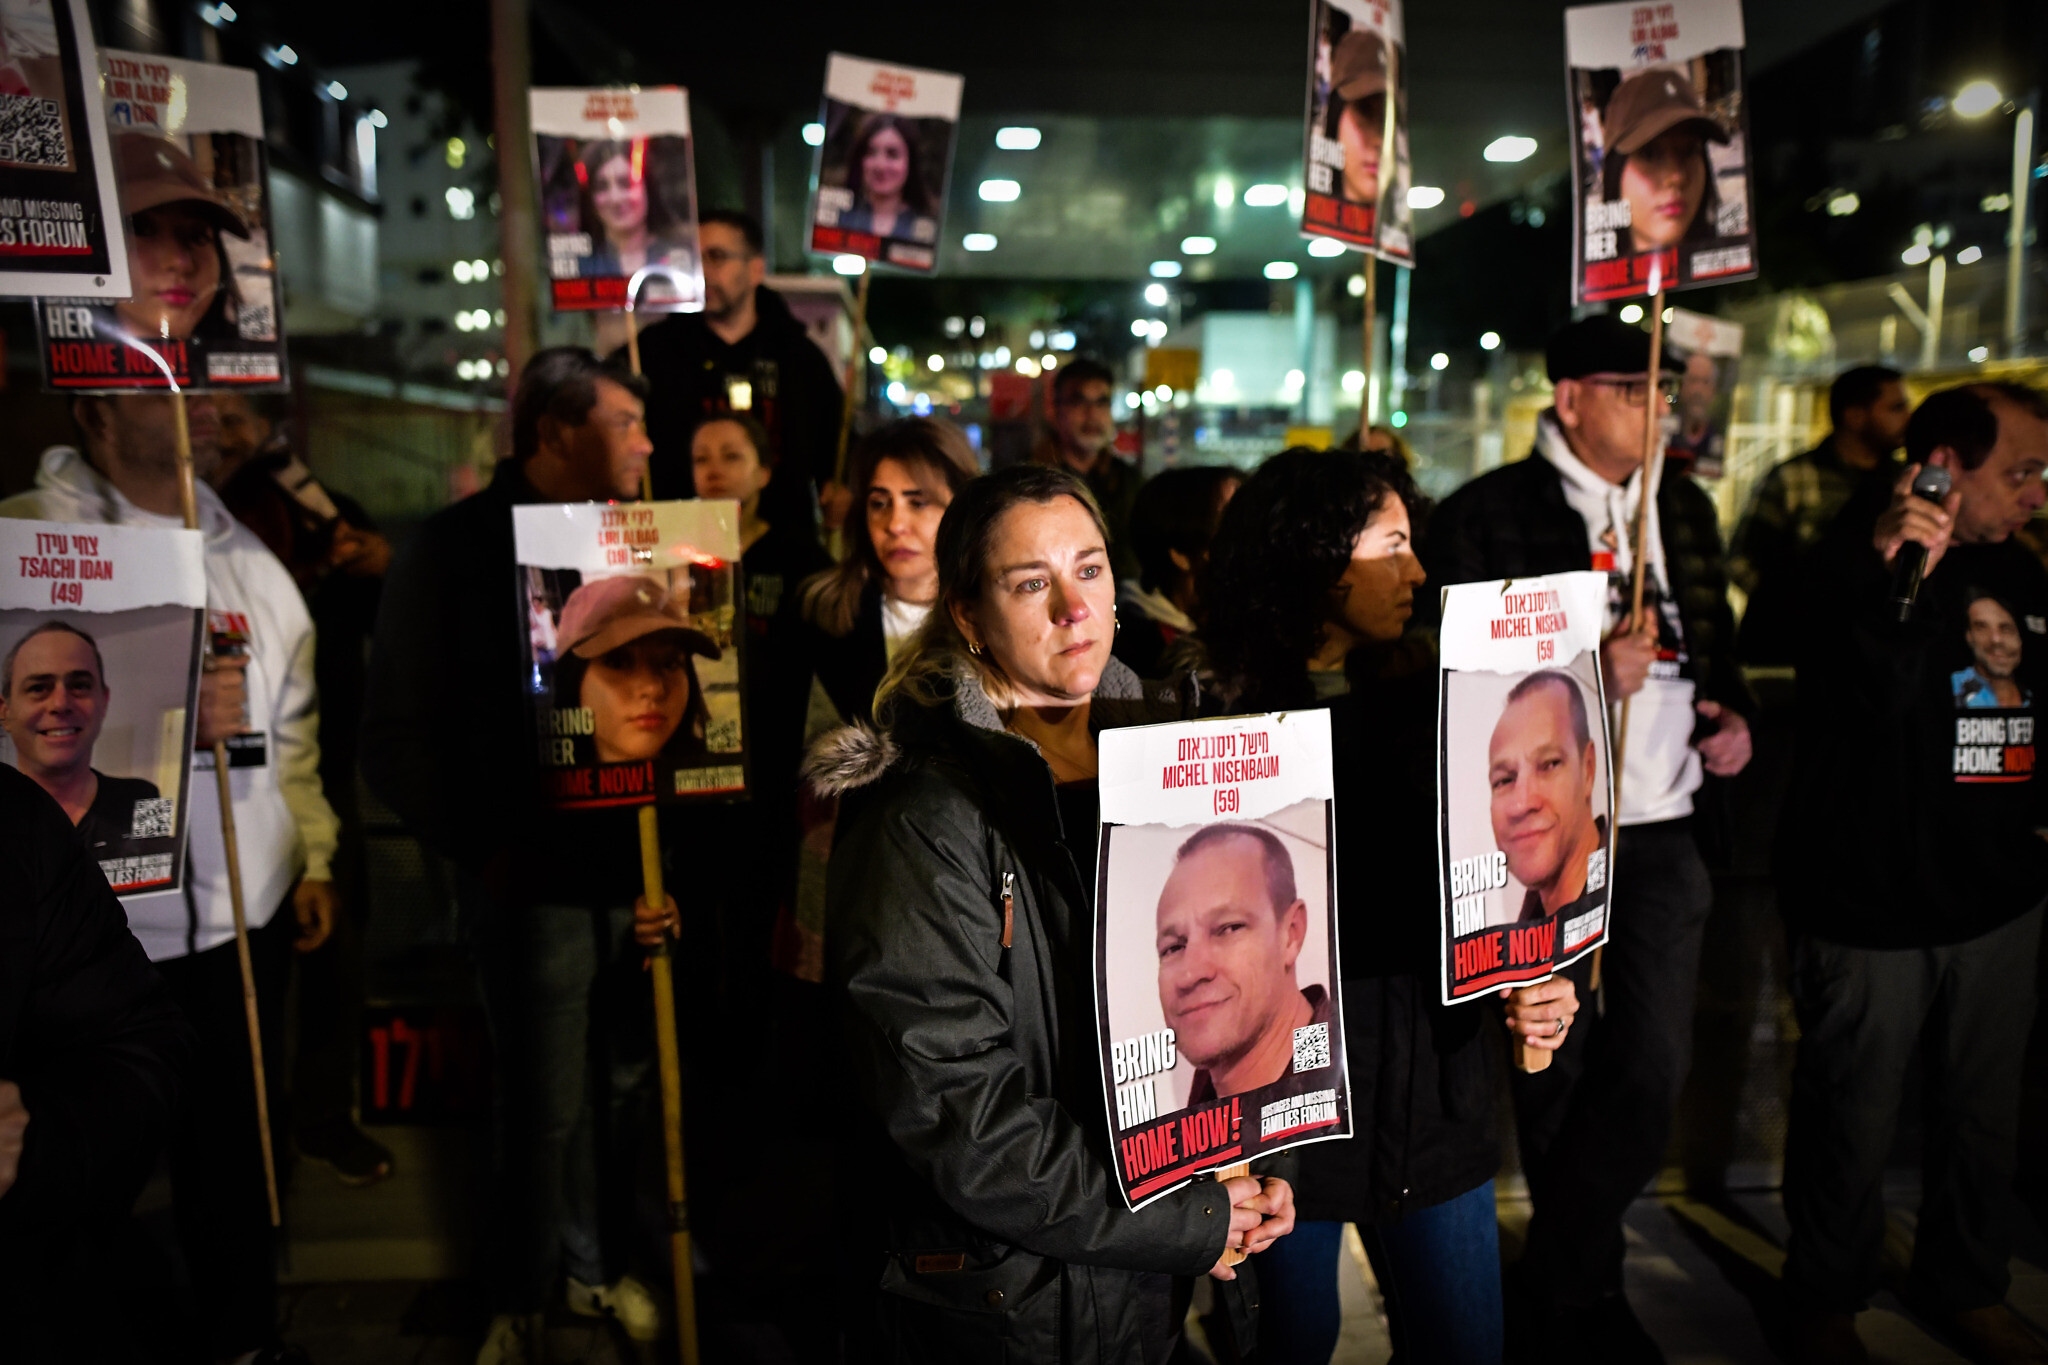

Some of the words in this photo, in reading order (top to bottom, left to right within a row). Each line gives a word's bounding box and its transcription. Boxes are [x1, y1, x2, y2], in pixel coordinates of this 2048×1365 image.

[24, 199, 84, 221] MISSING
[17, 219, 88, 248] FORUM
[1585, 231, 1618, 261] HER
[47, 305, 95, 338] HER
[50, 342, 118, 374] HOME
[36, 532, 68, 556] עידן
[72, 535, 99, 556] צחי
[19, 556, 76, 580] TSACHI
[79, 559, 114, 581] IDAN
[51, 581, 83, 606] (49)
[1490, 616, 1533, 640] MICHEL
[1239, 731, 1269, 756] מישל
[1956, 717, 2006, 746] BRING
[1177, 736, 1236, 762] ניסנבאום
[1952, 745, 2003, 774] HOME
[598, 760, 655, 793] NOW!
[1162, 765, 1209, 790] MICHEL
[1212, 755, 1280, 784] NISENBAUM
[1213, 787, 1240, 815] (59)
[1450, 850, 1508, 898] BRING
[1453, 894, 1486, 938] HIM
[1454, 931, 1504, 981] HOME
[1111, 1028, 1177, 1085] BRING
[1116, 1081, 1157, 1132] HIM
[1261, 1108, 1300, 1137] FAMILIES
[1301, 1101, 1338, 1126] FORUM
[1121, 1123, 1178, 1183] HOME
[1181, 1097, 1242, 1160] NOW!
